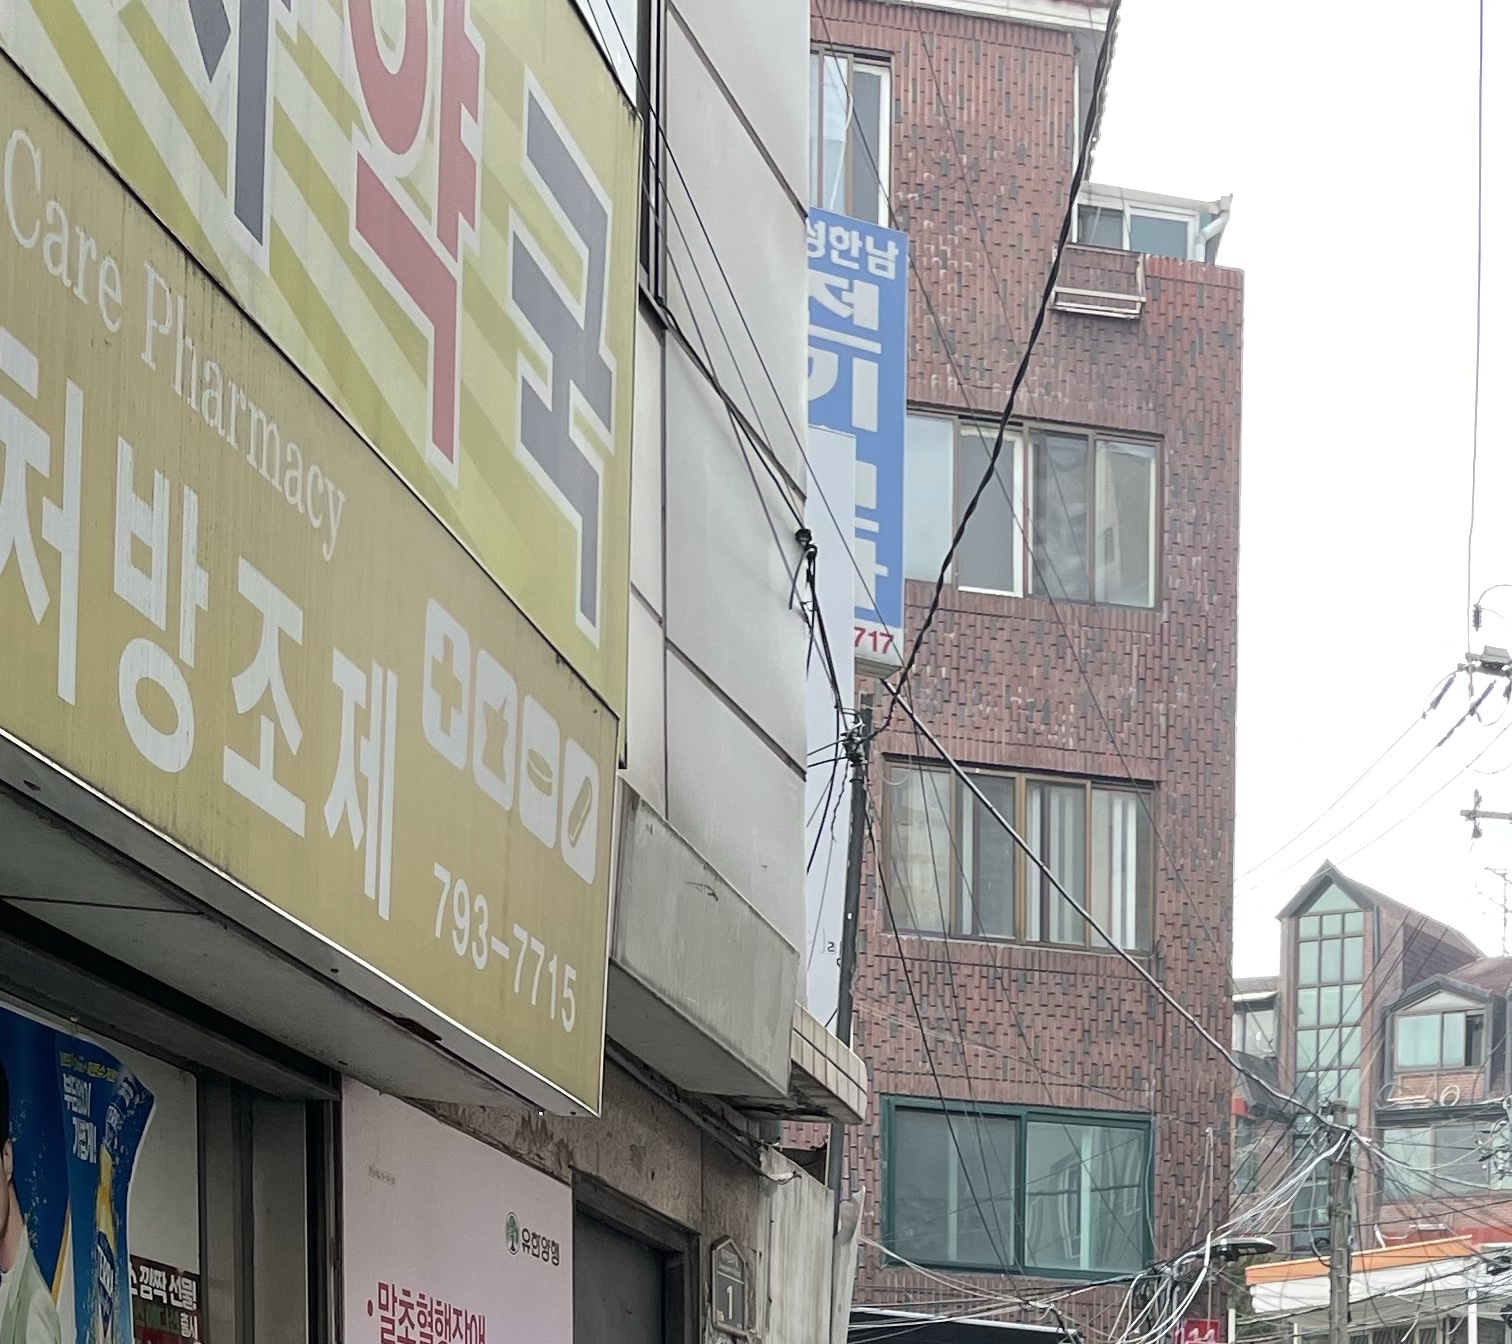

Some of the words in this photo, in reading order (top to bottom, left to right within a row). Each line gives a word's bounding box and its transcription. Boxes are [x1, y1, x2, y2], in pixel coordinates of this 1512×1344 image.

[3, 128, 123, 333] Care
[141, 260, 347, 562] Pharmacy
[189, 0, 615, 648] 약국
[0, 326, 400, 923] 처방조제
[432, 861, 578, 1034] 793-7715
[140, 1265, 168, 1304] 깜짝
[169, 1274, 197, 1311] 선물!
[521, 1228, 560, 1267] 유한양행
[726, 1285, 733, 1320] 1
